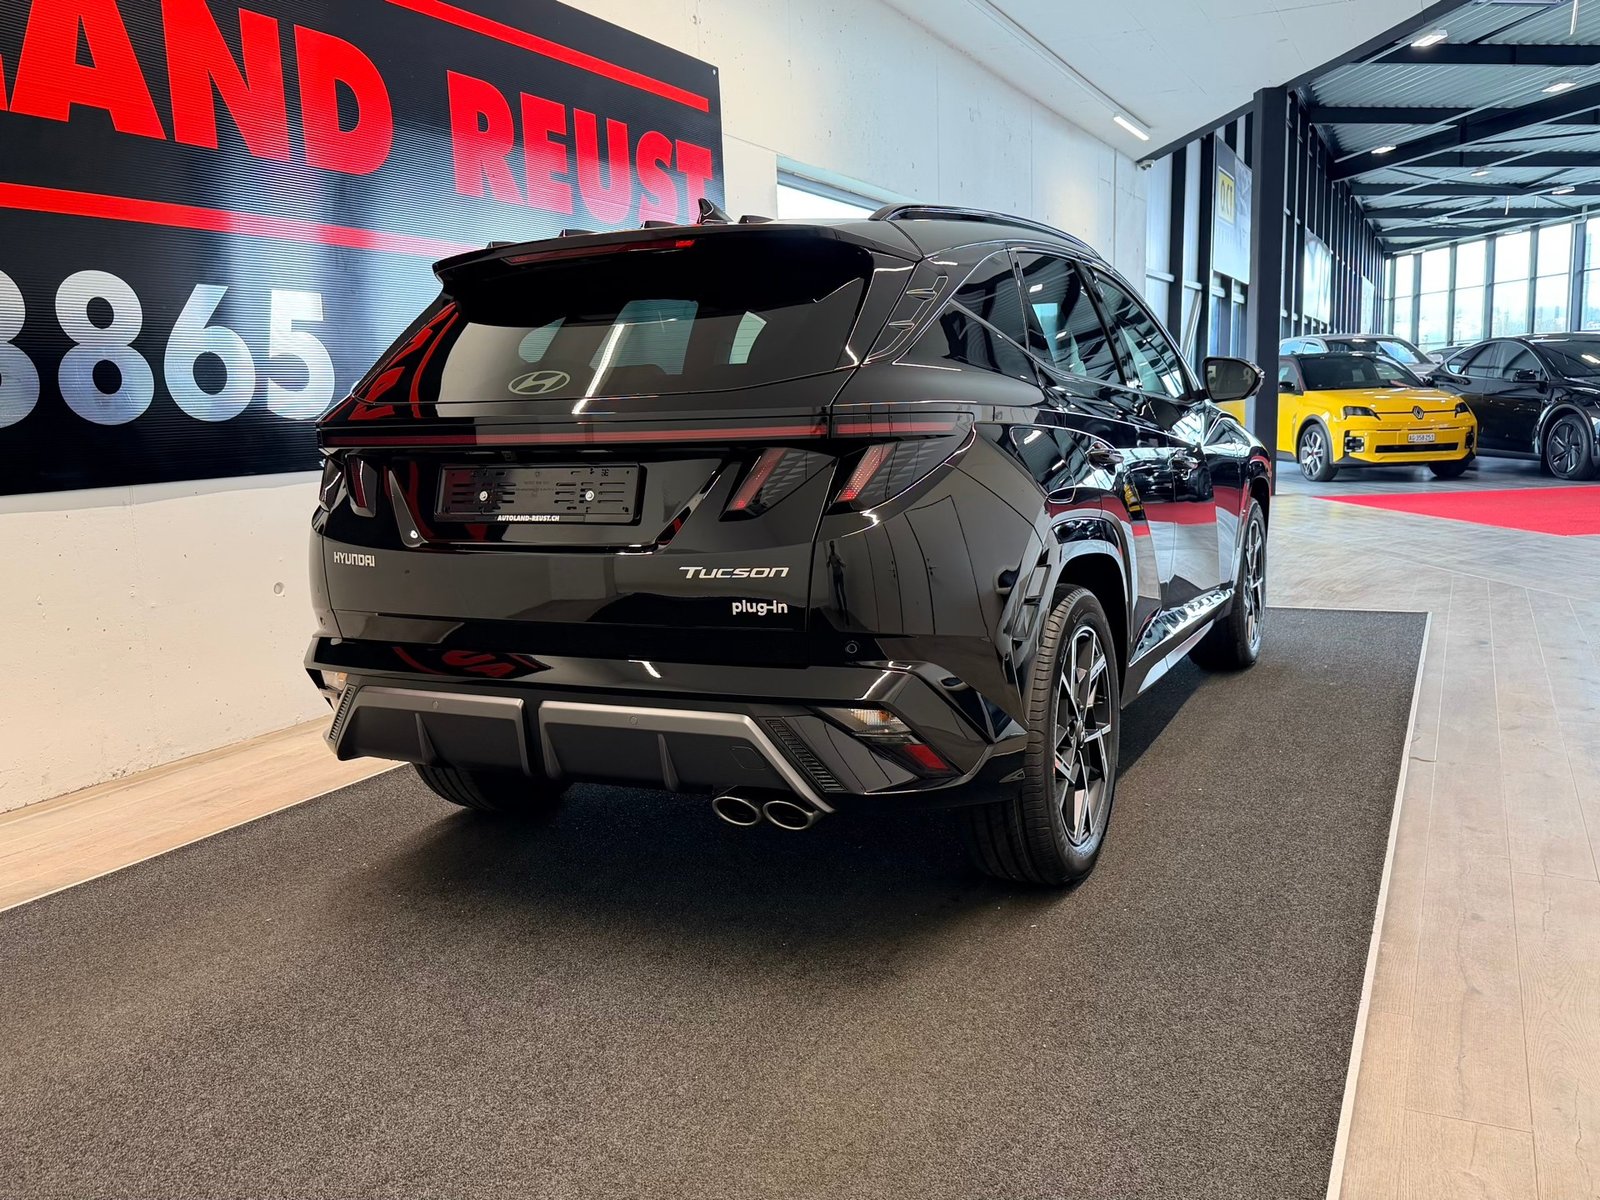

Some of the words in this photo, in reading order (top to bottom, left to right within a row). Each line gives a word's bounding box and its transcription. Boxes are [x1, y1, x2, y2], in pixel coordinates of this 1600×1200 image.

[0, 0, 393, 175] AND
[447, 70, 713, 225] REUST
[497, 514, 561, 523] AUTOLAND-REUST.CH
[334, 551, 376, 567] HYUNDAI
[731, 600, 788, 617] plug-in
